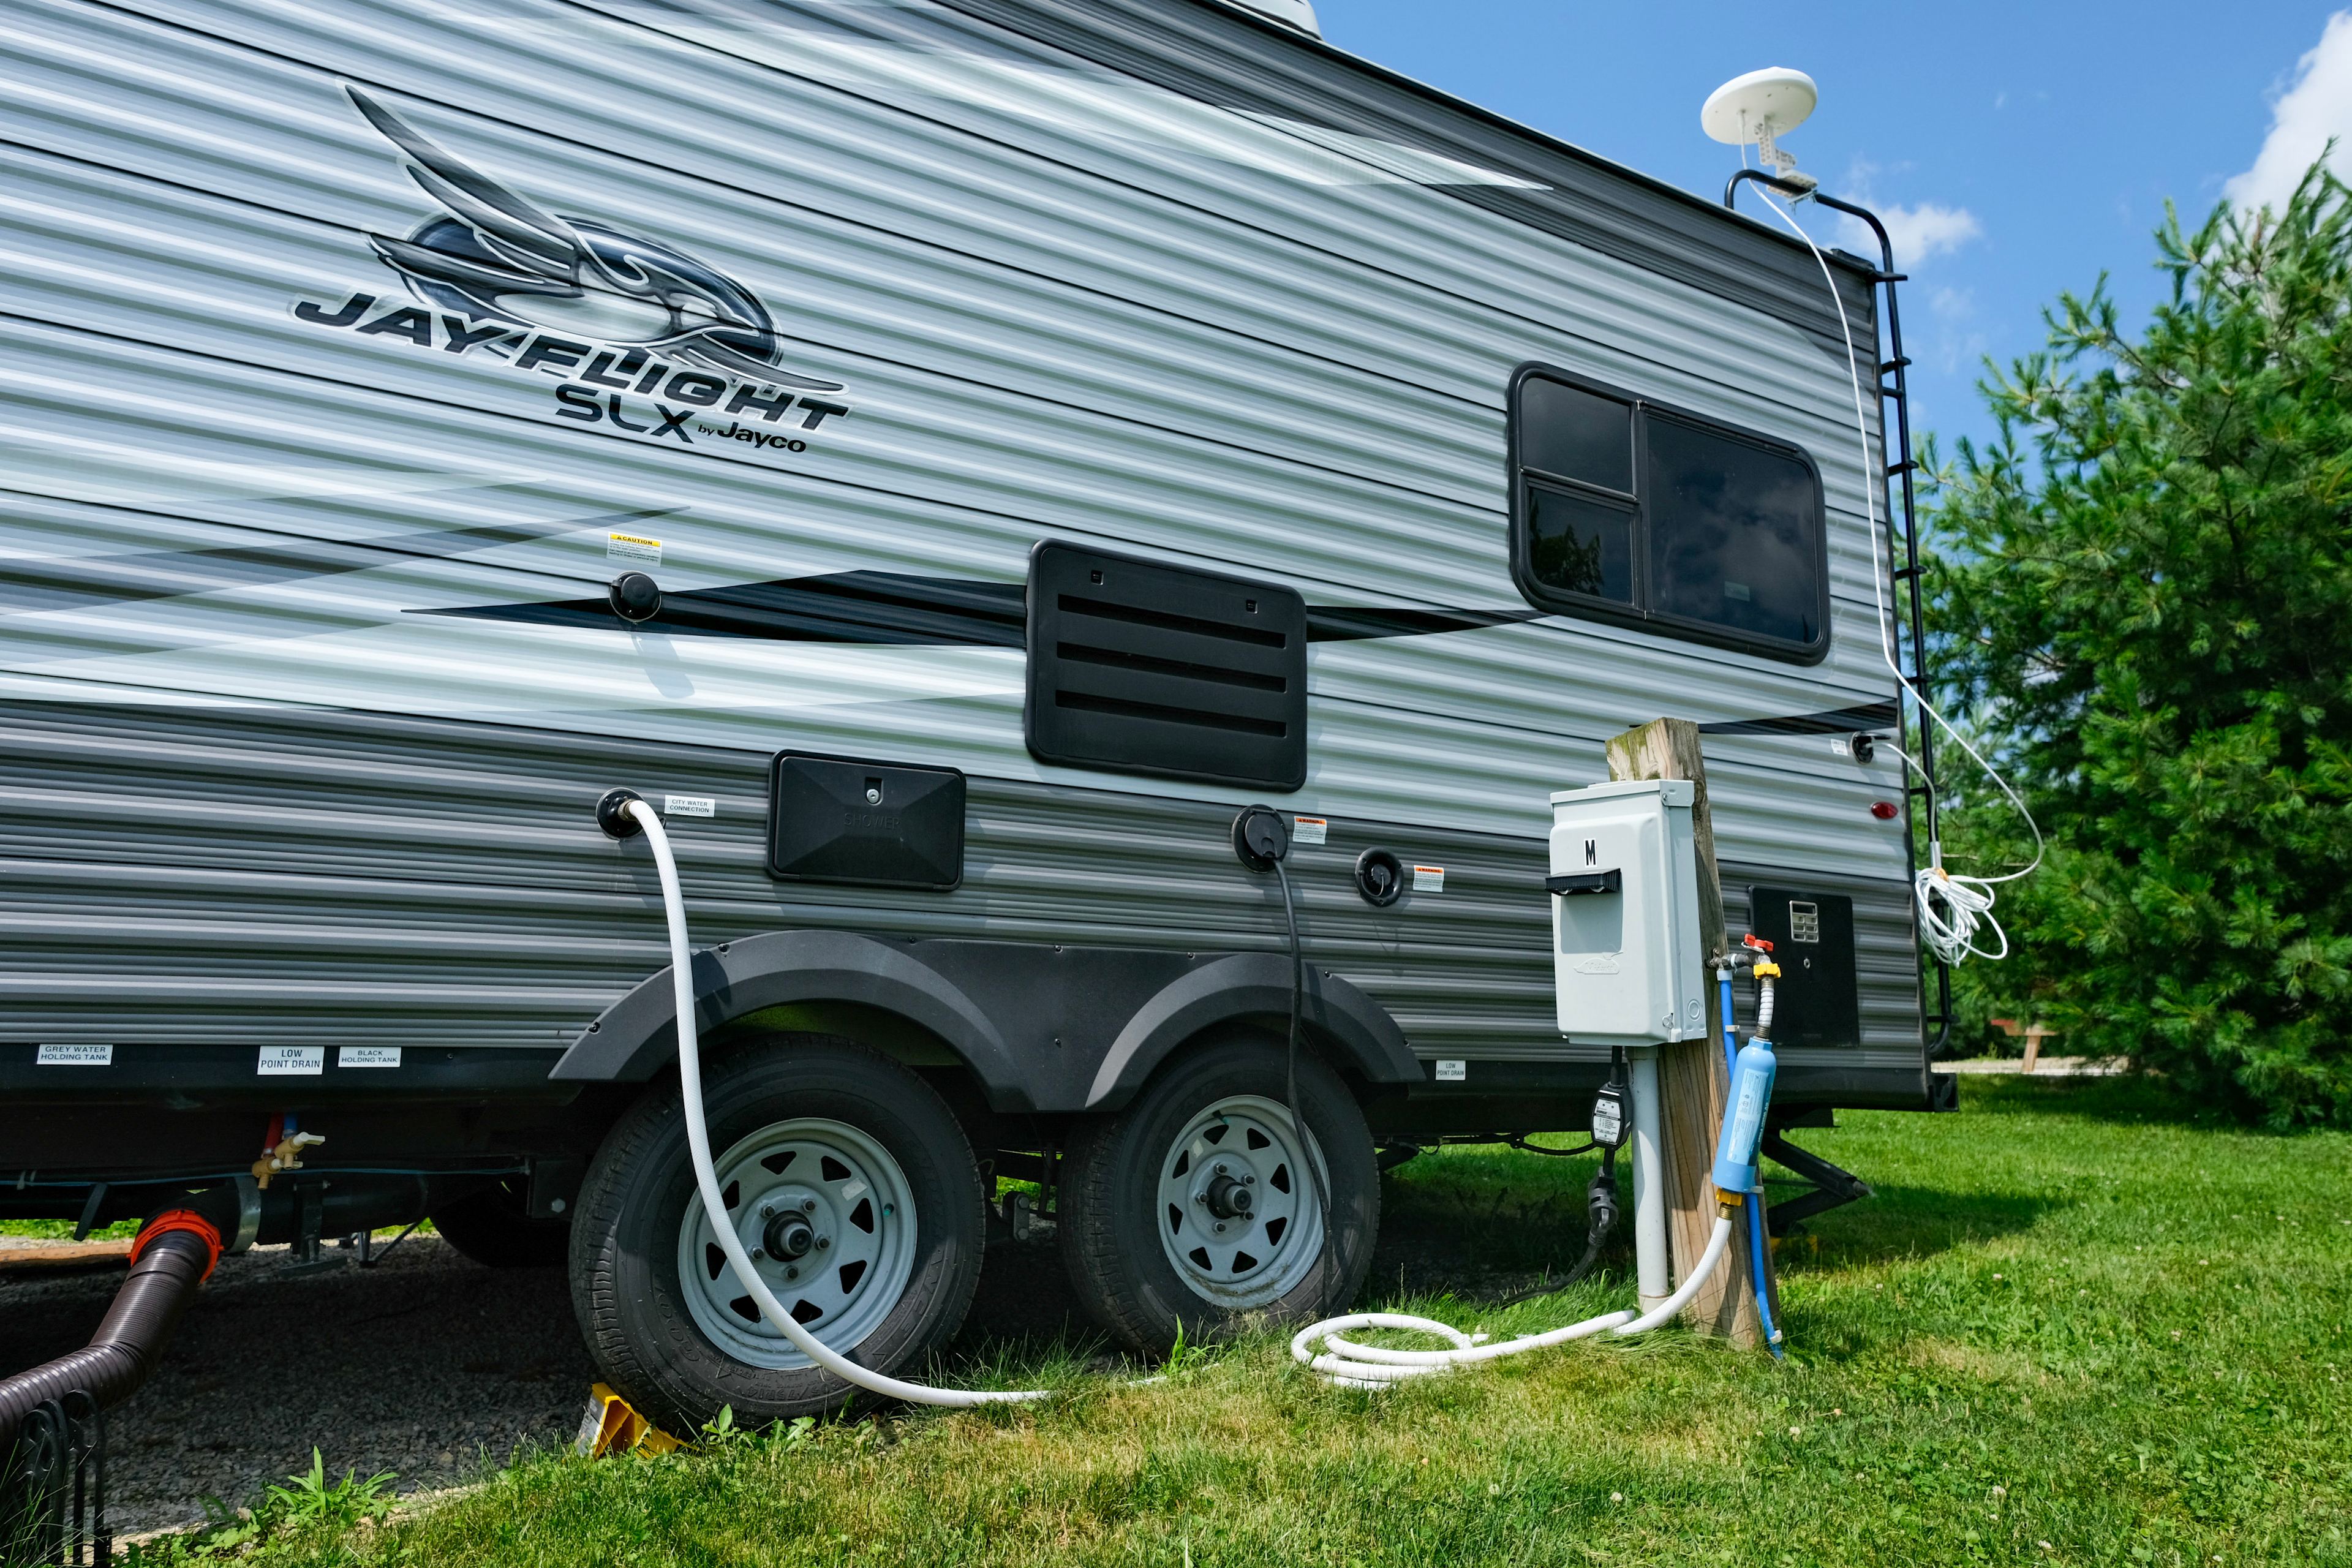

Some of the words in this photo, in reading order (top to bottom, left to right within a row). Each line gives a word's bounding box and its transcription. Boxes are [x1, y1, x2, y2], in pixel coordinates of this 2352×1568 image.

[295, 292, 511, 354] JAY
[515, 334, 850, 431] FLIGHT
[556, 383, 696, 445] SLX
[698, 424, 715, 436] by
[717, 421, 807, 453] Jayco
[622, 536, 653, 546] CAUTION
[843, 812, 902, 829] SHOWER
[1585, 839, 1597, 867] M
[281, 1049, 303, 1058] LOW
[261, 1060, 290, 1068] POINT
[292, 1060, 320, 1068] DRAIN
